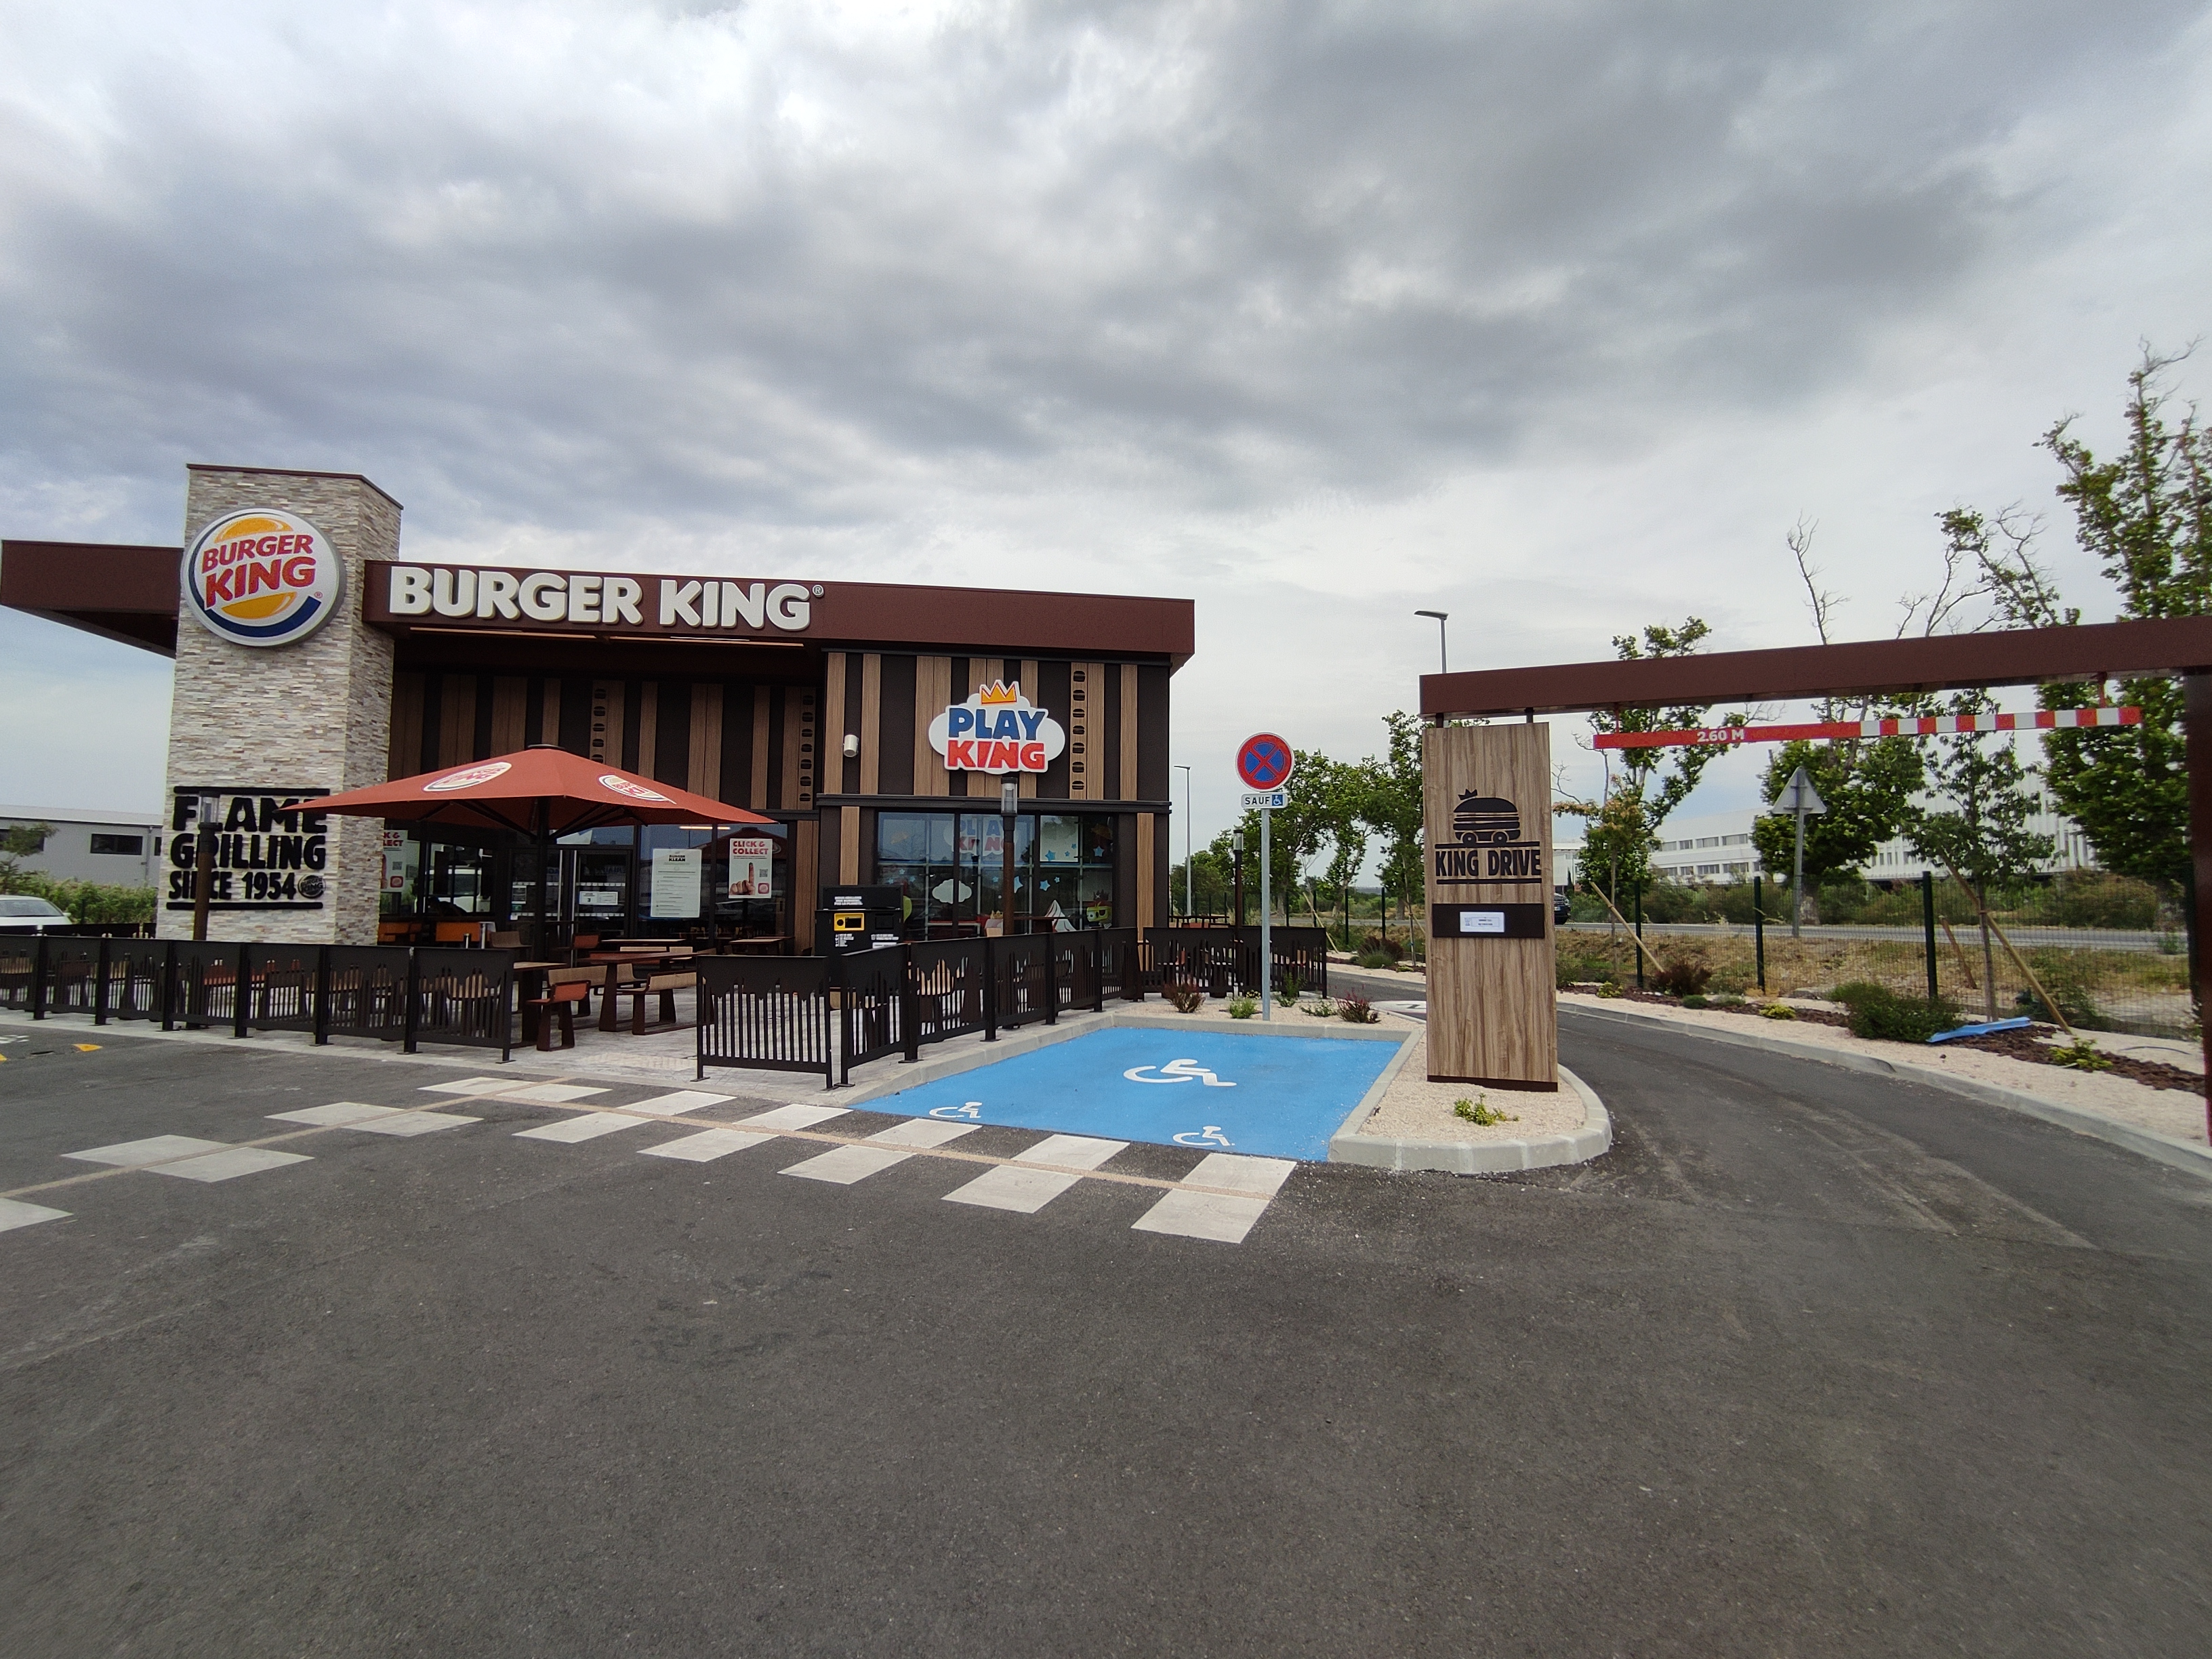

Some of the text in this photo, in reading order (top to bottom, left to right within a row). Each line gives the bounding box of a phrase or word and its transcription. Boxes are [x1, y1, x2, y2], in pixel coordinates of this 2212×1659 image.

[201, 534, 314, 574] BURGER
[205, 556, 316, 608] KING
[390, 566, 811, 631] BURGER KING
[948, 708, 1046, 740] PLAY
[1697, 729, 1745, 743] 2.60 M
[947, 740, 1045, 769] KING
[172, 796, 327, 833] FAME
[1245, 796, 1270, 805] SAUF
[1435, 850, 1542, 876] KING DRIVE
[241, 872, 296, 899] 1954
